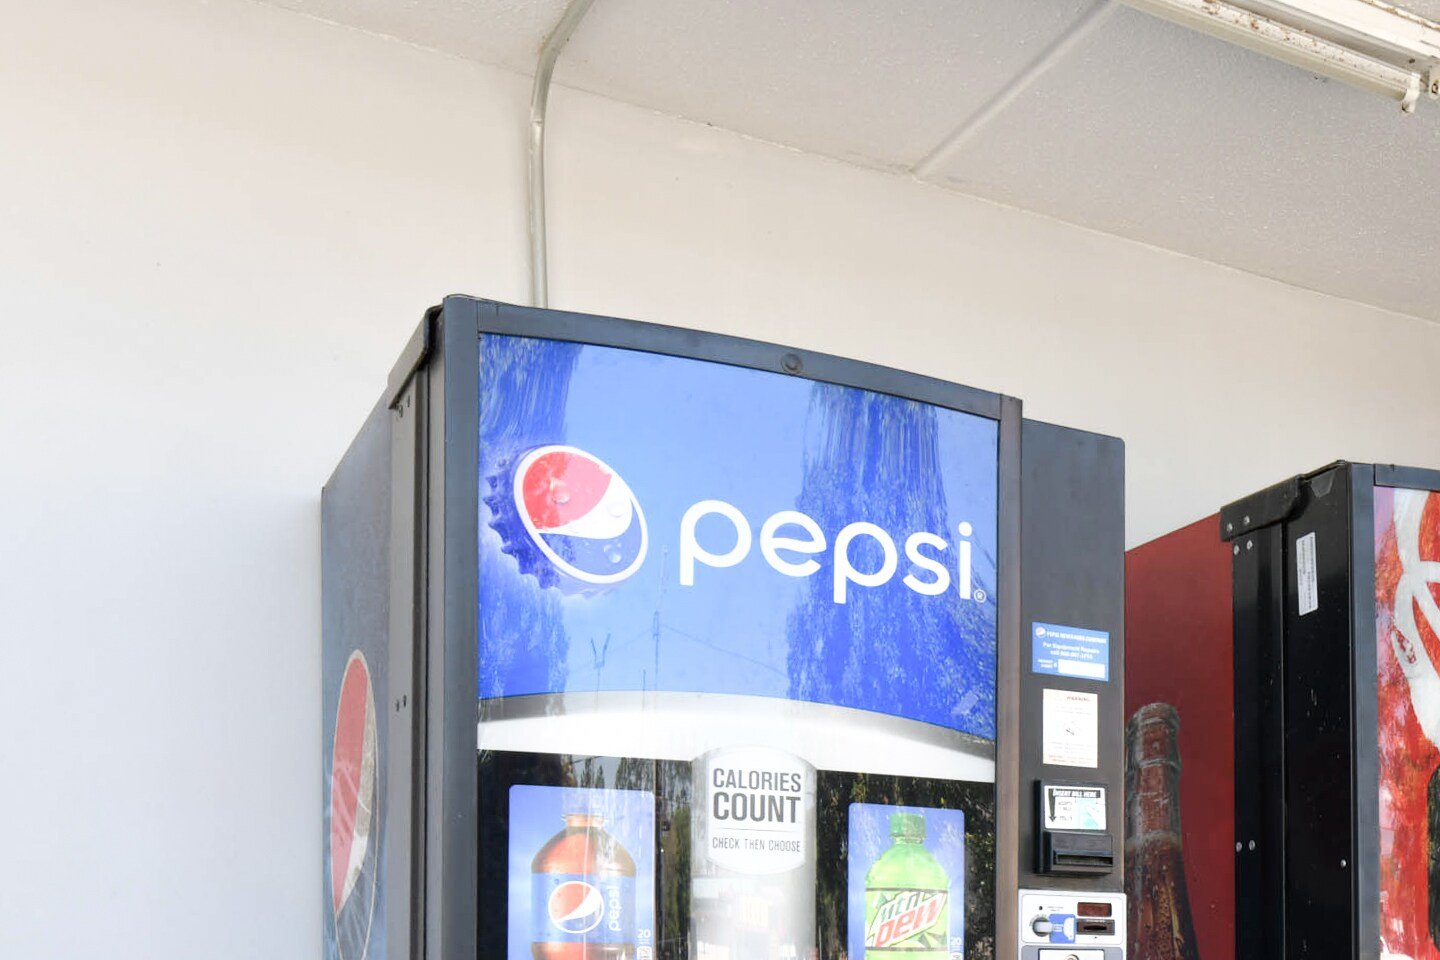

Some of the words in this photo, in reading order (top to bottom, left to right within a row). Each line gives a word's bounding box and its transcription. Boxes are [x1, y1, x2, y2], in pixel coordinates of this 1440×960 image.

[679, 499, 973, 604] pepsi
[713, 768, 801, 793] CALORIES
[713, 791, 801, 823] COUNT
[712, 837, 740, 849] CHECK
[744, 838, 765, 850] THEN
[768, 840, 801, 852] CHOOSE
[607, 885, 622, 931] pepsi
[637, 929, 651, 938] 20
